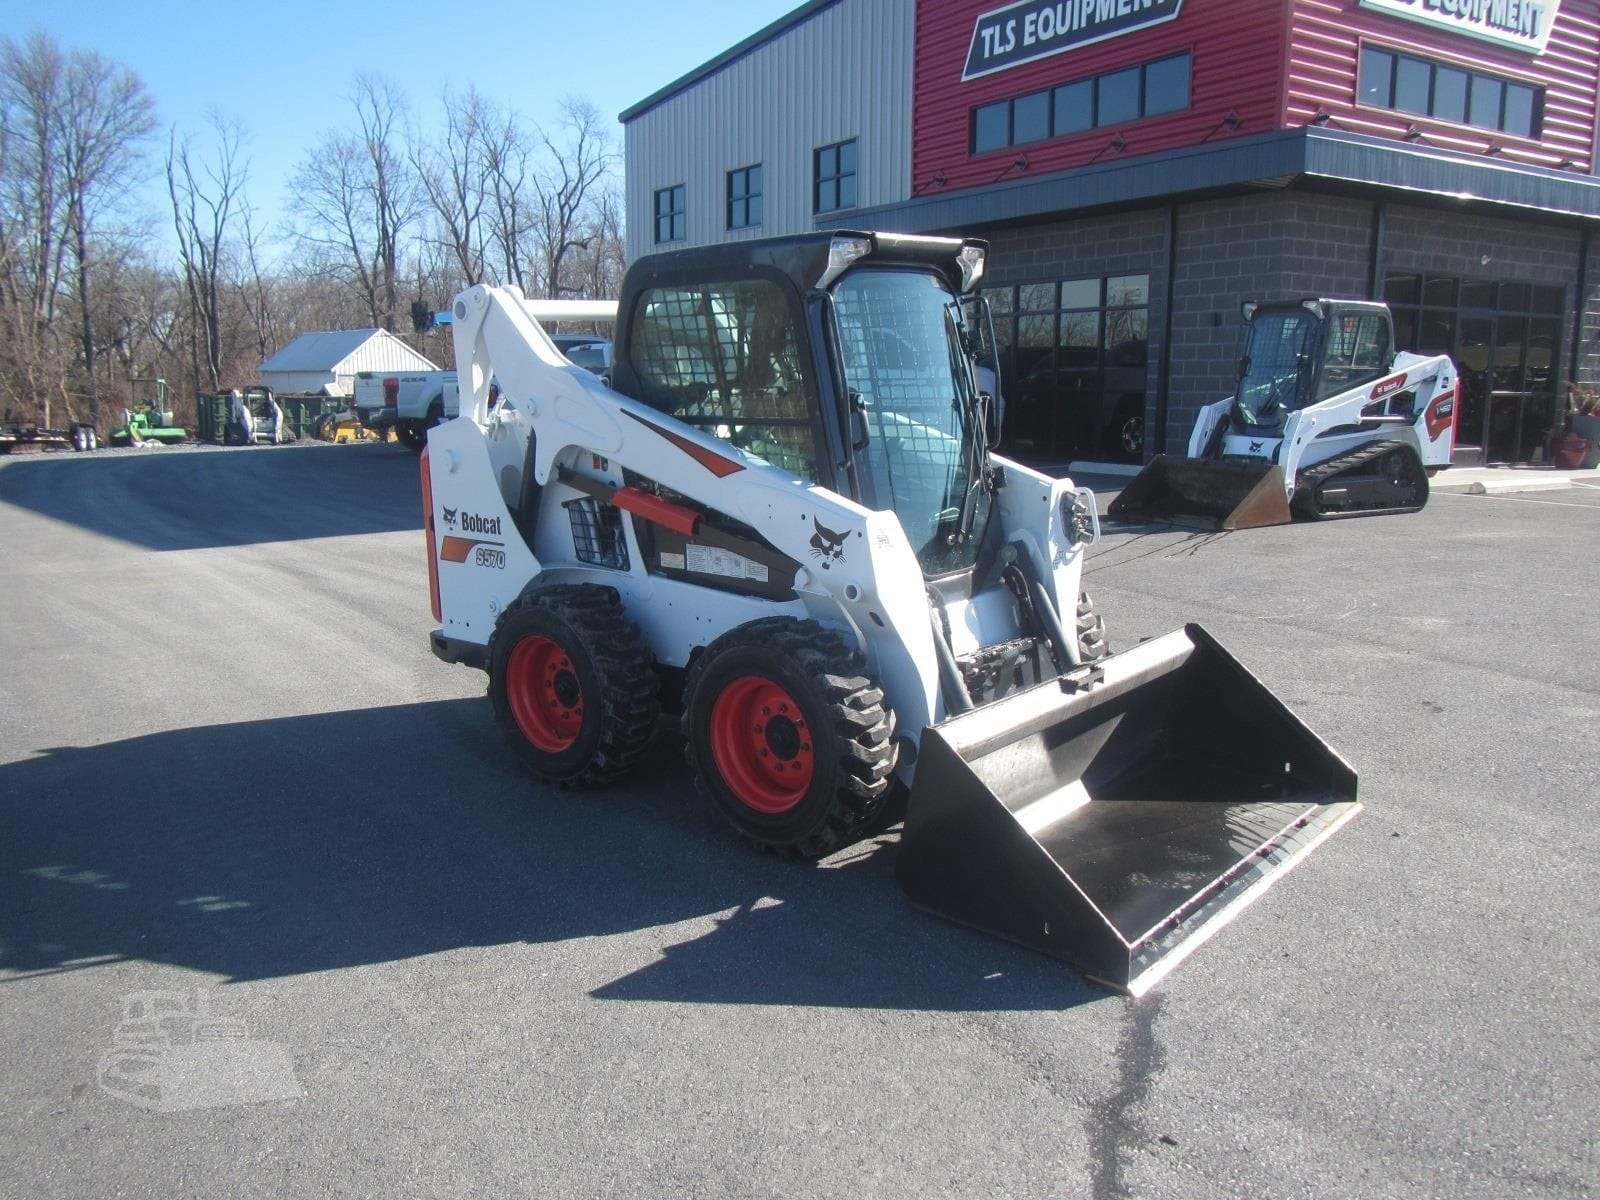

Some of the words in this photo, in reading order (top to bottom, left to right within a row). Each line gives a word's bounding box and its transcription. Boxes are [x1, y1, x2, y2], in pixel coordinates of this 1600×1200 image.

[981, 19, 1016, 59] TLS
[1023, 0, 1166, 46] EQUIPM
[461, 512, 501, 535] Bobcat
[476, 547, 505, 569] S570
